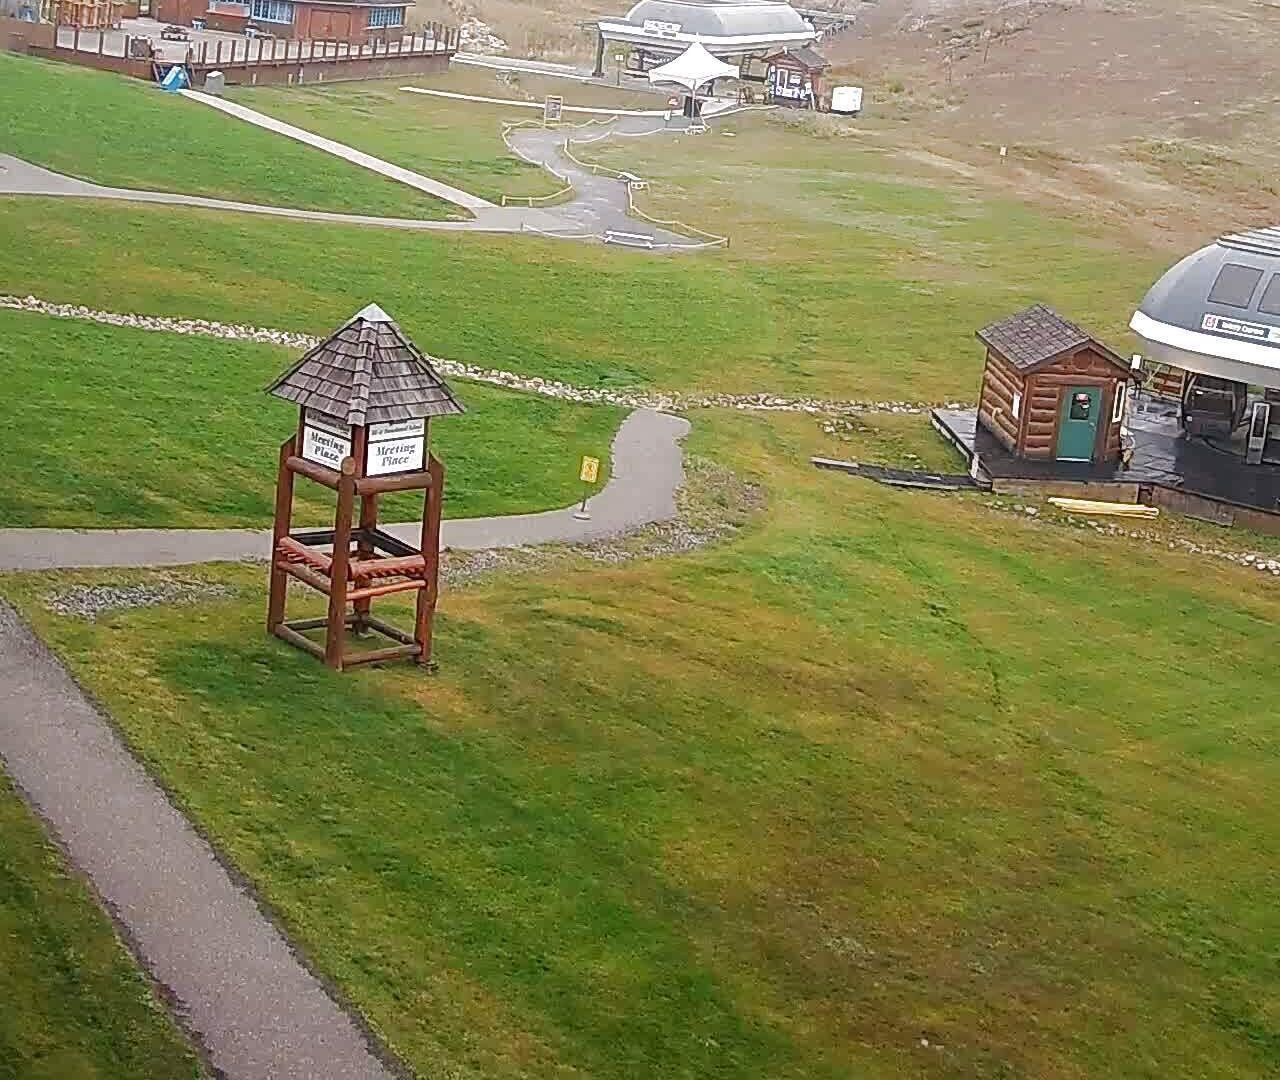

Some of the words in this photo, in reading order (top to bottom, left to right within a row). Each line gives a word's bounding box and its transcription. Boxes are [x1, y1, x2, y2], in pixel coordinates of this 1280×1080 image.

[311, 431, 345, 455] Meeting
[376, 443, 416, 457] Meeting
[314, 445, 339, 463] Place
[381, 456, 410, 467] Place
